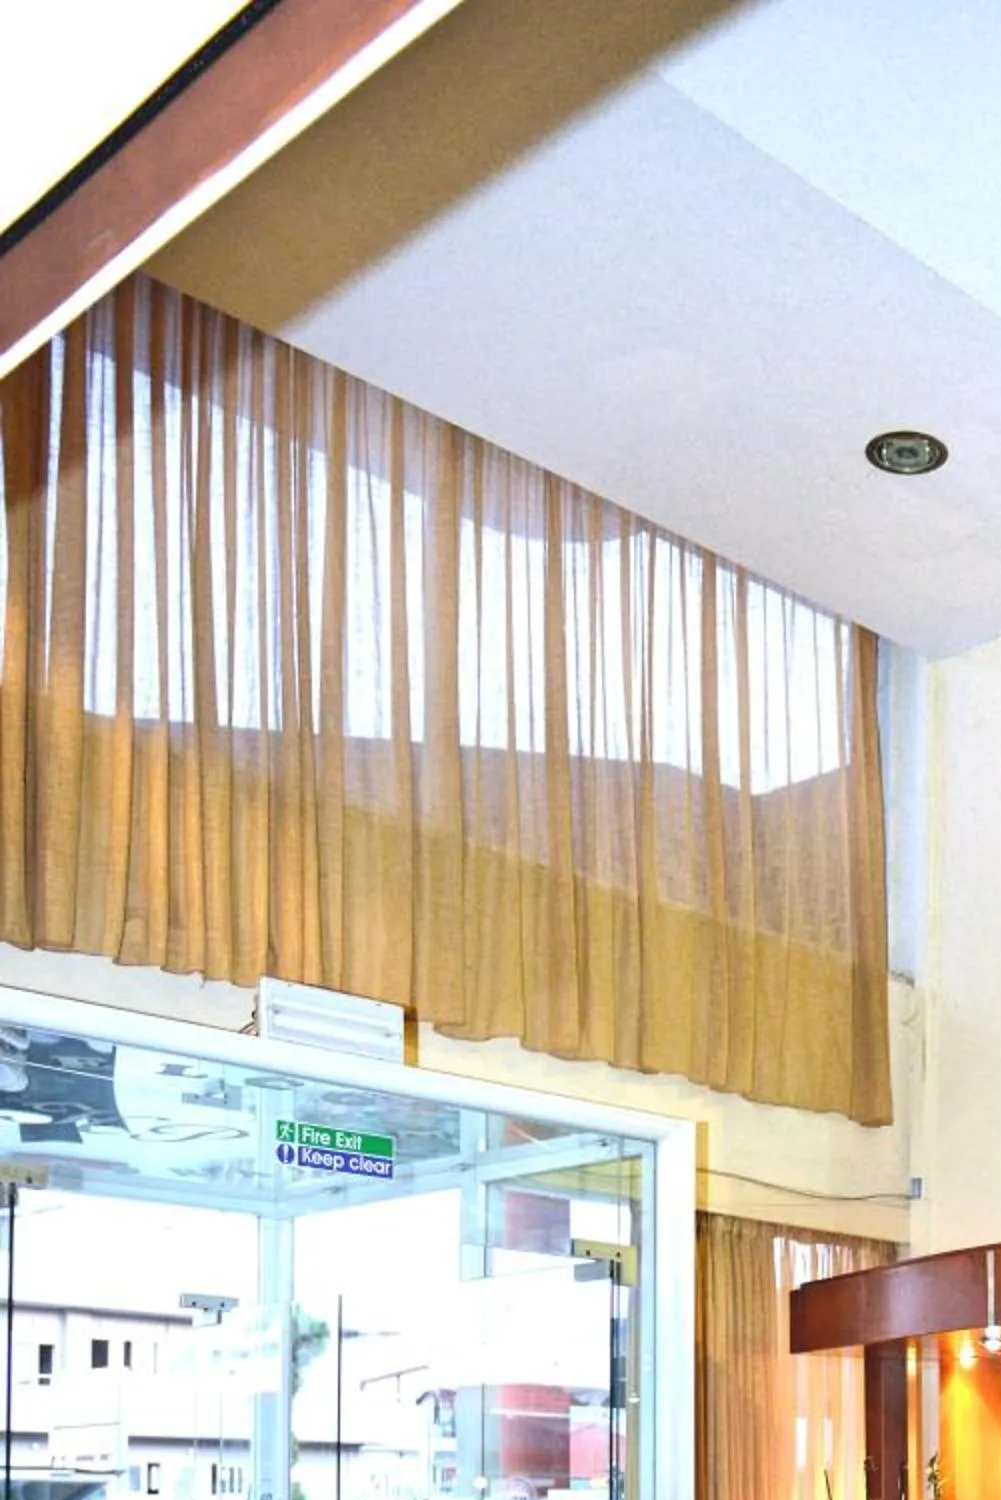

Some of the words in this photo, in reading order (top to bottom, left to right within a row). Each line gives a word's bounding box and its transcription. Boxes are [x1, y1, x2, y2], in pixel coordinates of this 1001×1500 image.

[302, 1127, 331, 1145] Fire
[335, 1132, 362, 1150] Exit
[302, 1148, 345, 1170] Keep
[349, 1156, 391, 1175] clear
